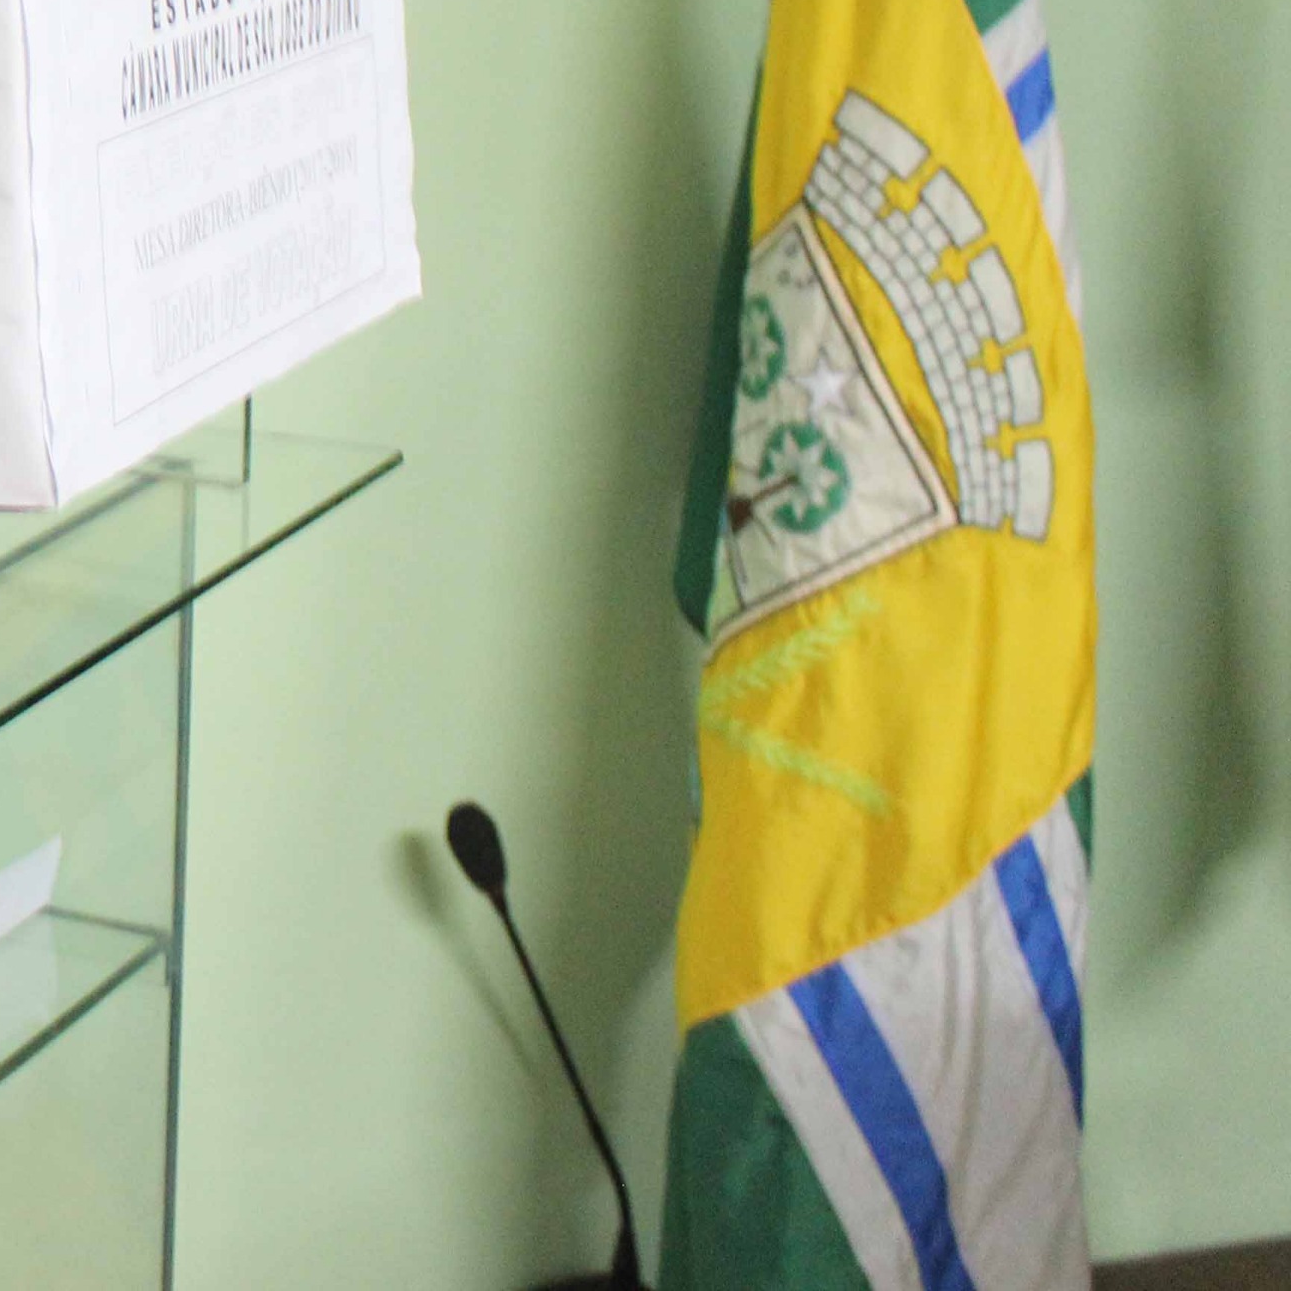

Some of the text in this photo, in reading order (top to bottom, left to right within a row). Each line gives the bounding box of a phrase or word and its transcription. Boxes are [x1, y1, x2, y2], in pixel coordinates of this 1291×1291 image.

[120, 39, 171, 123] CÂMARA
[171, 19, 235, 99] MUNICIPAL
[236, 12, 251, 73] DE
